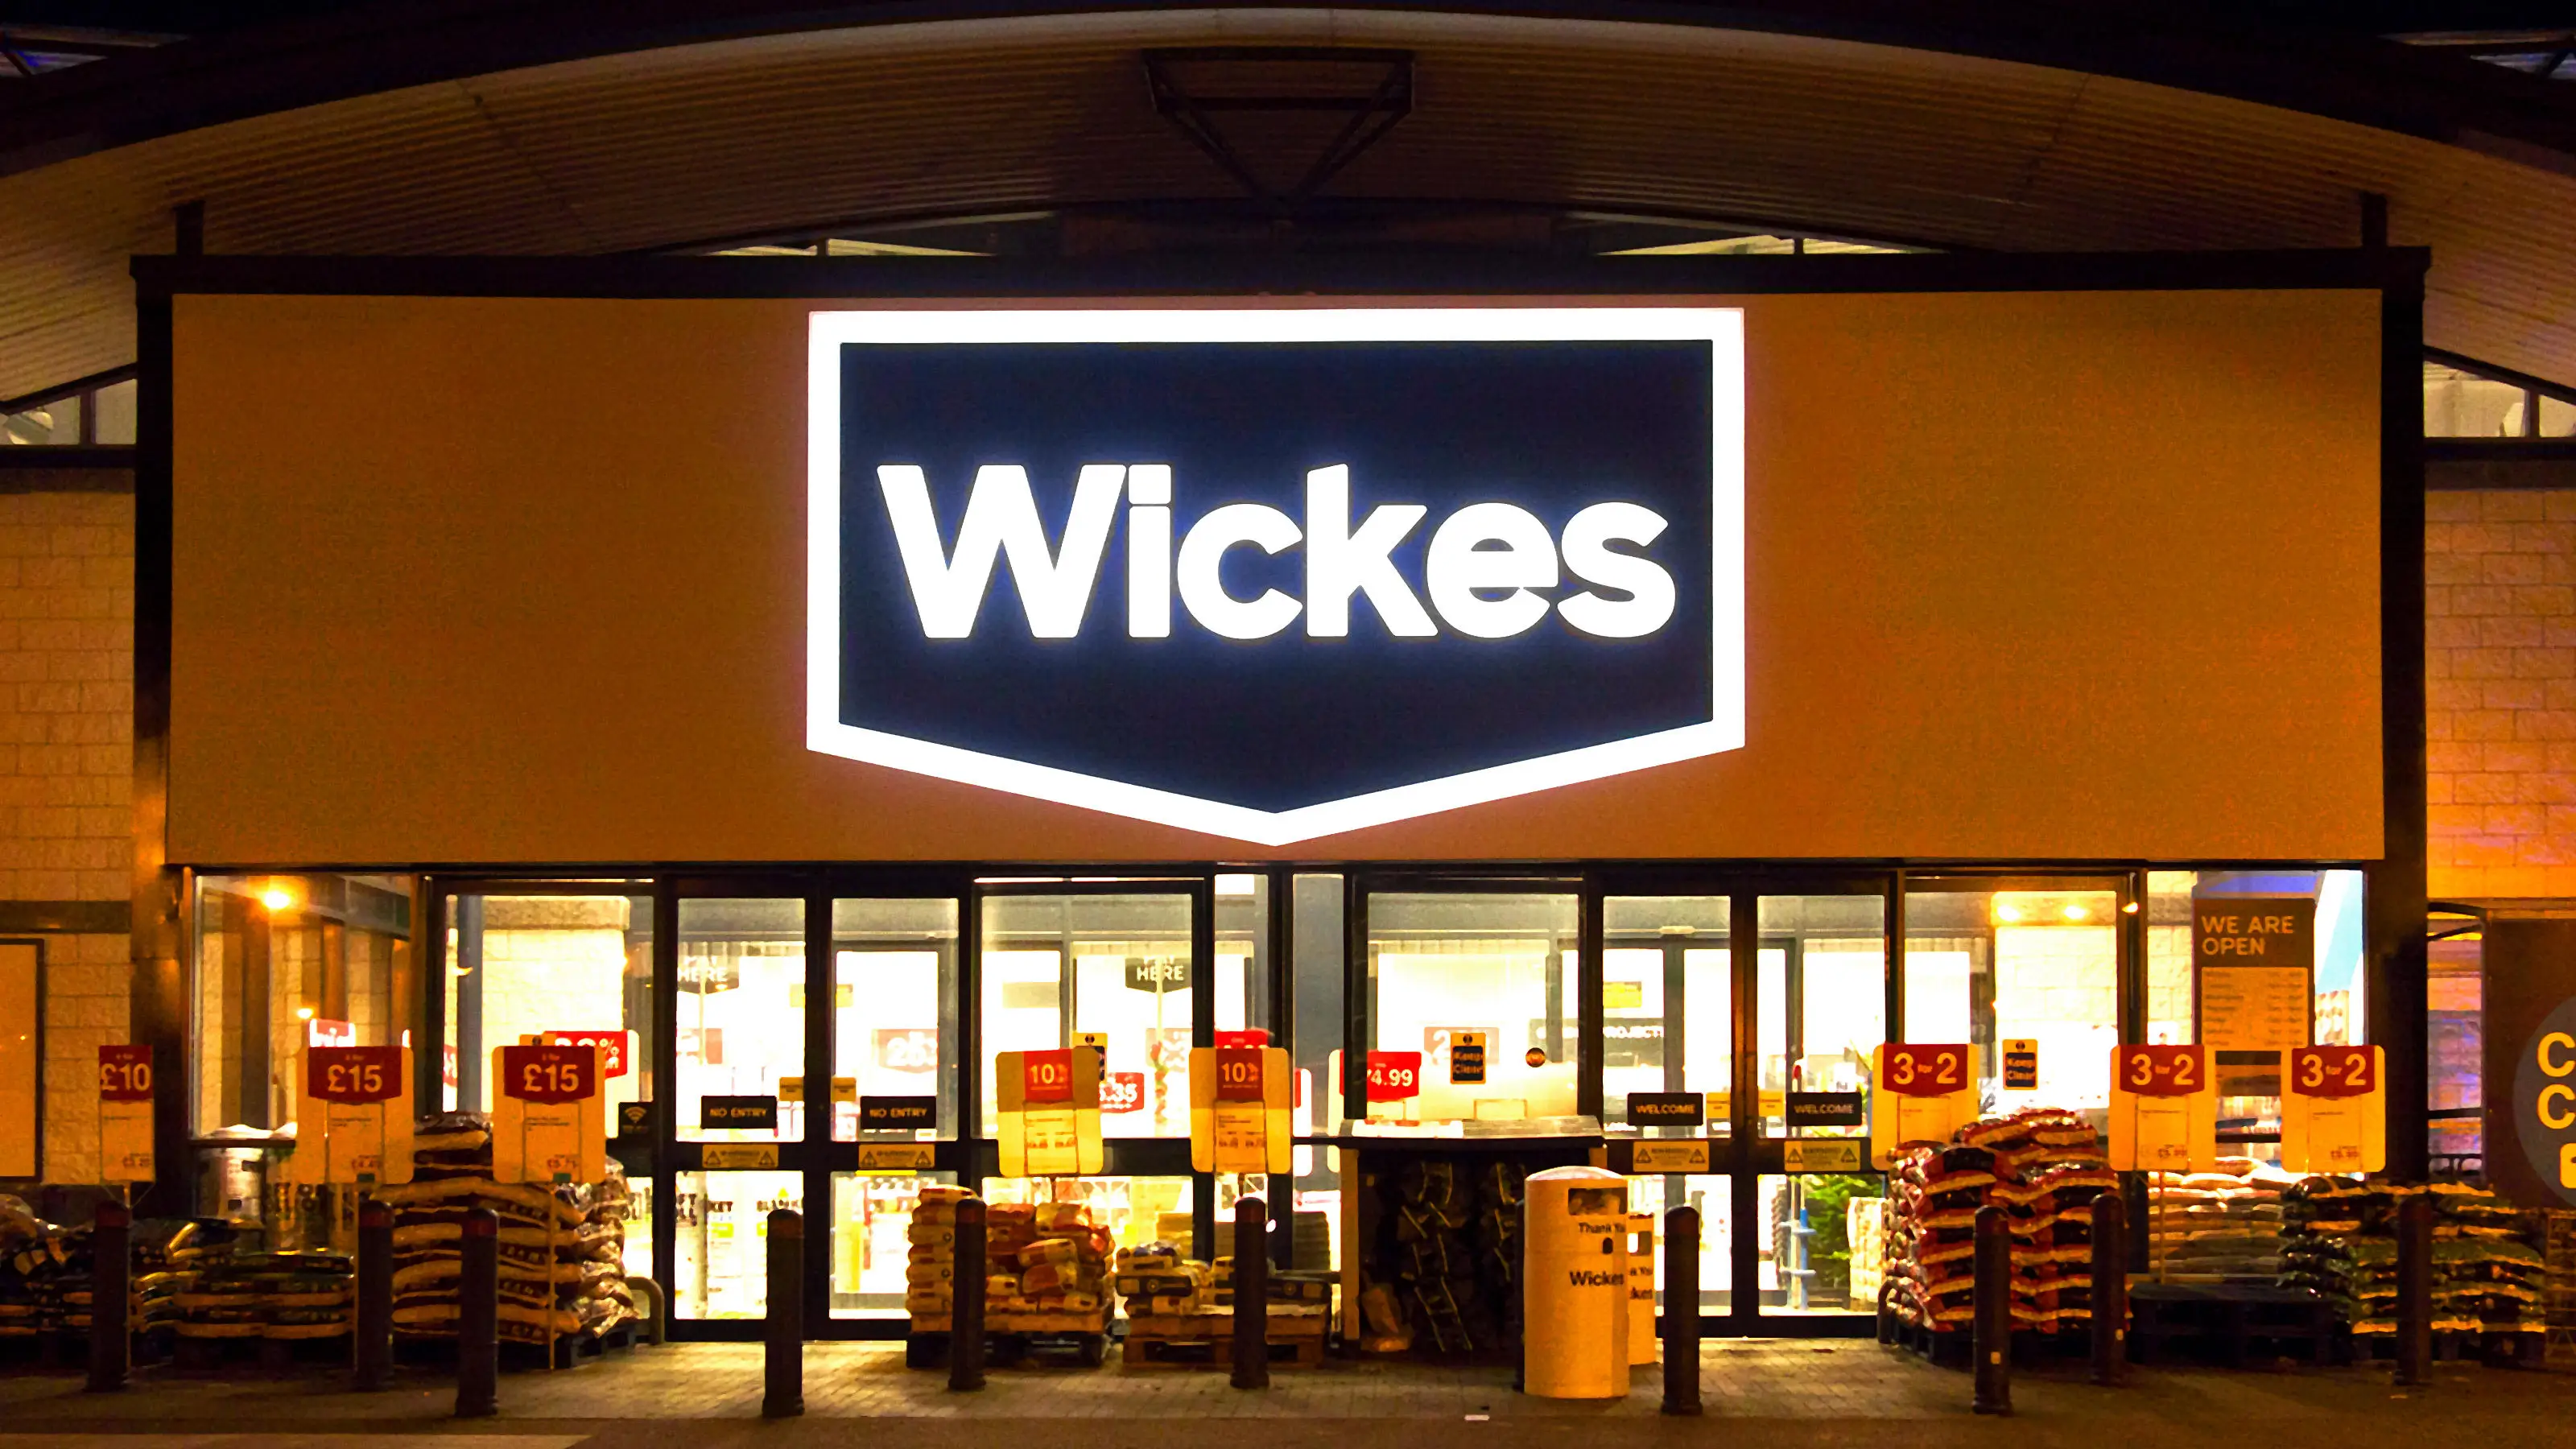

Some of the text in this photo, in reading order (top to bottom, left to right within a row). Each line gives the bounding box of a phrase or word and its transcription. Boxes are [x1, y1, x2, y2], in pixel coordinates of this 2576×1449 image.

[877, 463, 1676, 640] Wickes
[2201, 915, 2294, 934] WE ARE
[2202, 937, 2266, 956] OPEN
[1136, 966, 1184, 981] HERE
[101, 1063, 151, 1091] £10
[523, 1063, 579, 1092] £15
[1893, 1052, 1914, 1084] 3
[1936, 1052, 1957, 1084] 2
[2131, 1054, 2152, 1085] 3
[2174, 1054, 2194, 1085] 2
[2301, 1054, 2323, 1087] 3
[2345, 1054, 2367, 1086] 2
[328, 1064, 382, 1092] £15
[710, 1108, 768, 1118] NO ENTRY
[869, 1108, 927, 1118] NO ENTRY
[1636, 1104, 1696, 1114] WELCOME
[1794, 1103, 1854, 1114] WELCOME
[1578, 1222, 1612, 1233] Thank
